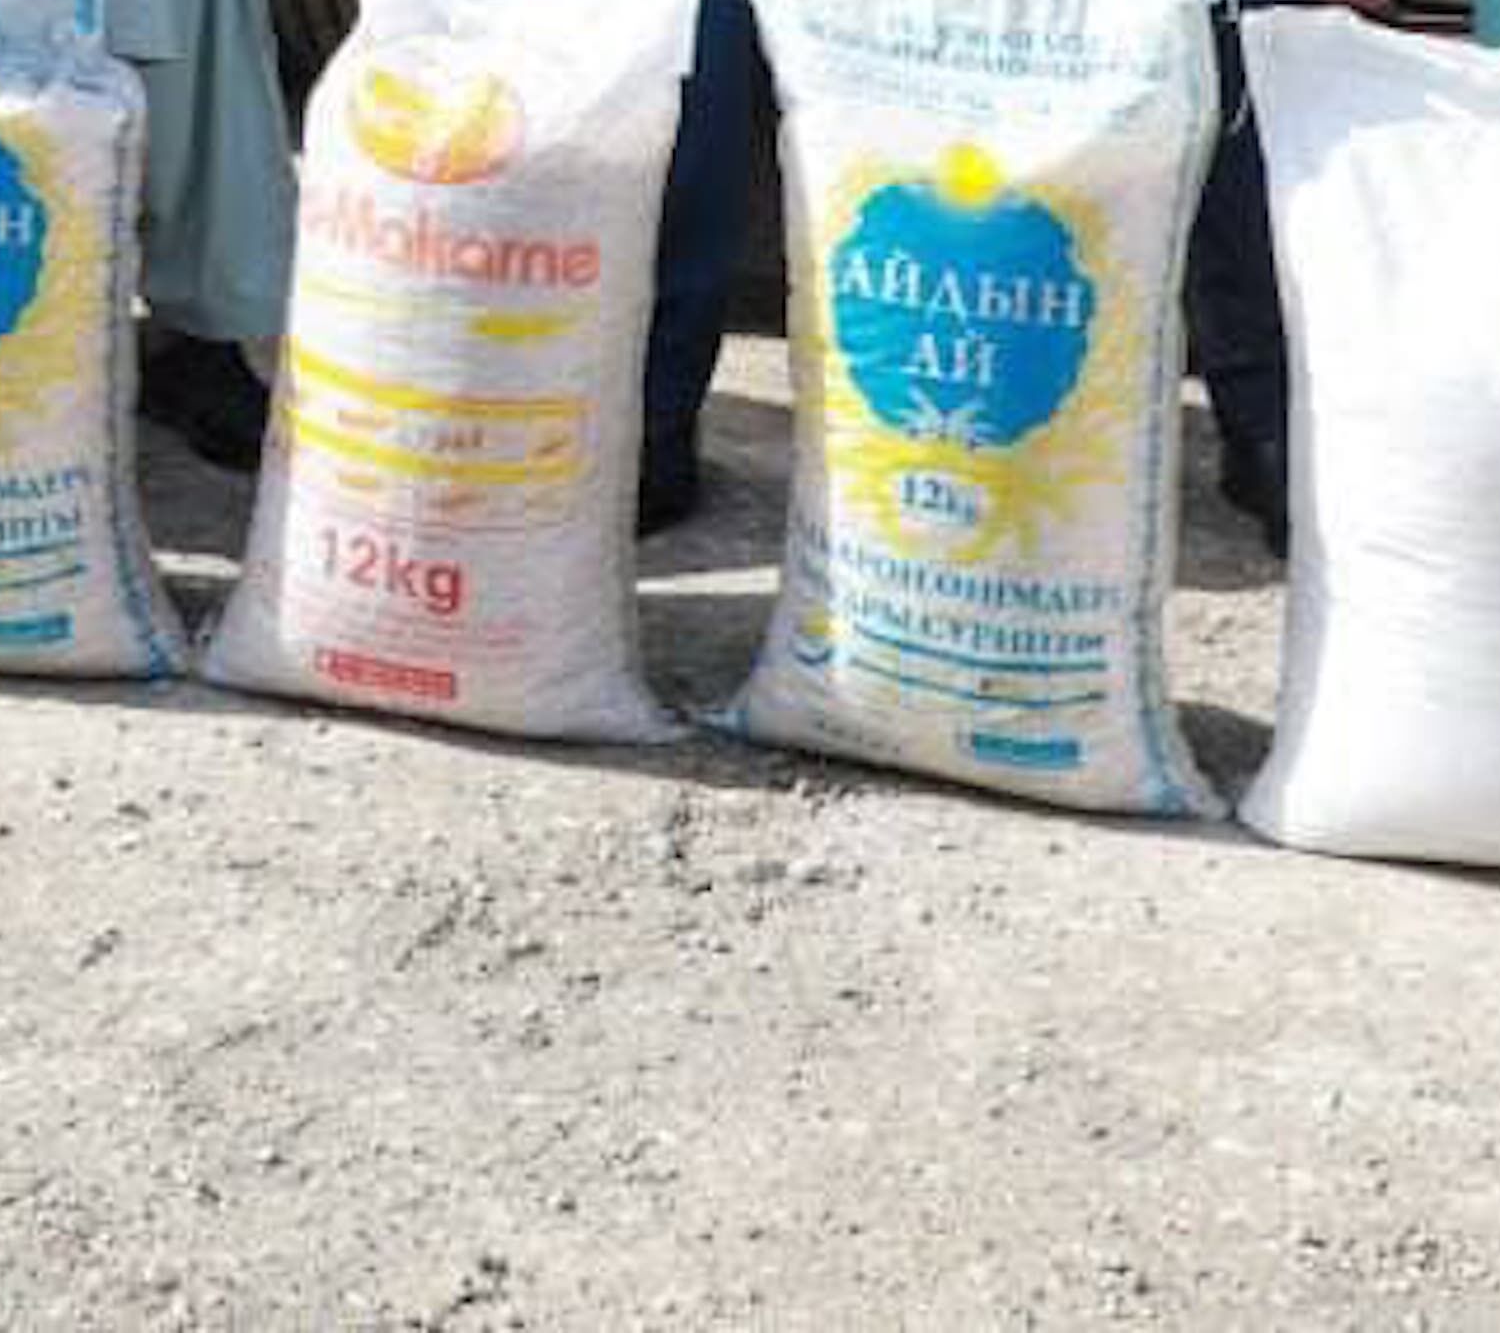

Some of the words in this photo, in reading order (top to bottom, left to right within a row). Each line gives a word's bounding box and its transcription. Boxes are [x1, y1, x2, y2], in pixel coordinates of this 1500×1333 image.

[840, 247, 1082, 326] АЙДЫН
[900, 328, 998, 387] АЙ
[319, 528, 462, 616] 12kg
